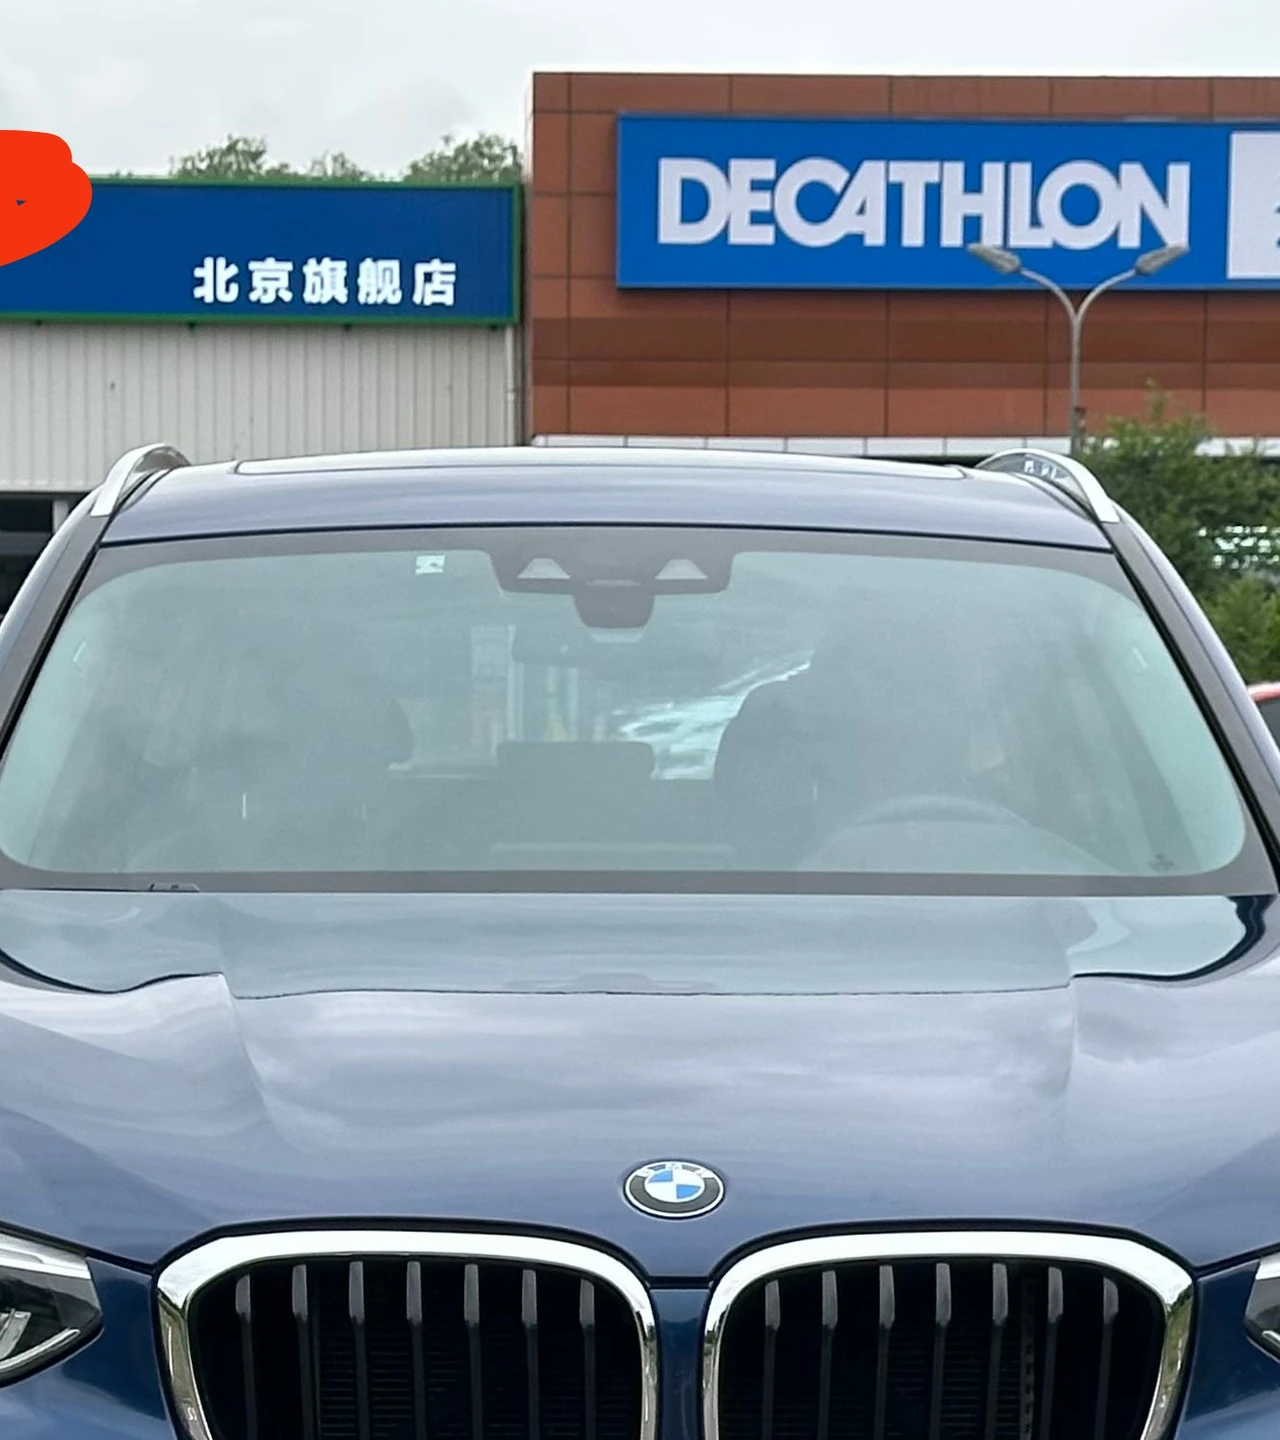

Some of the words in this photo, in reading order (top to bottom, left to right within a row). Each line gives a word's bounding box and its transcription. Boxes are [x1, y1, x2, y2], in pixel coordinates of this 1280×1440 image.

[658, 157, 1190, 249] DECATHLON
[193, 257, 456, 306] 北京旗舰店
